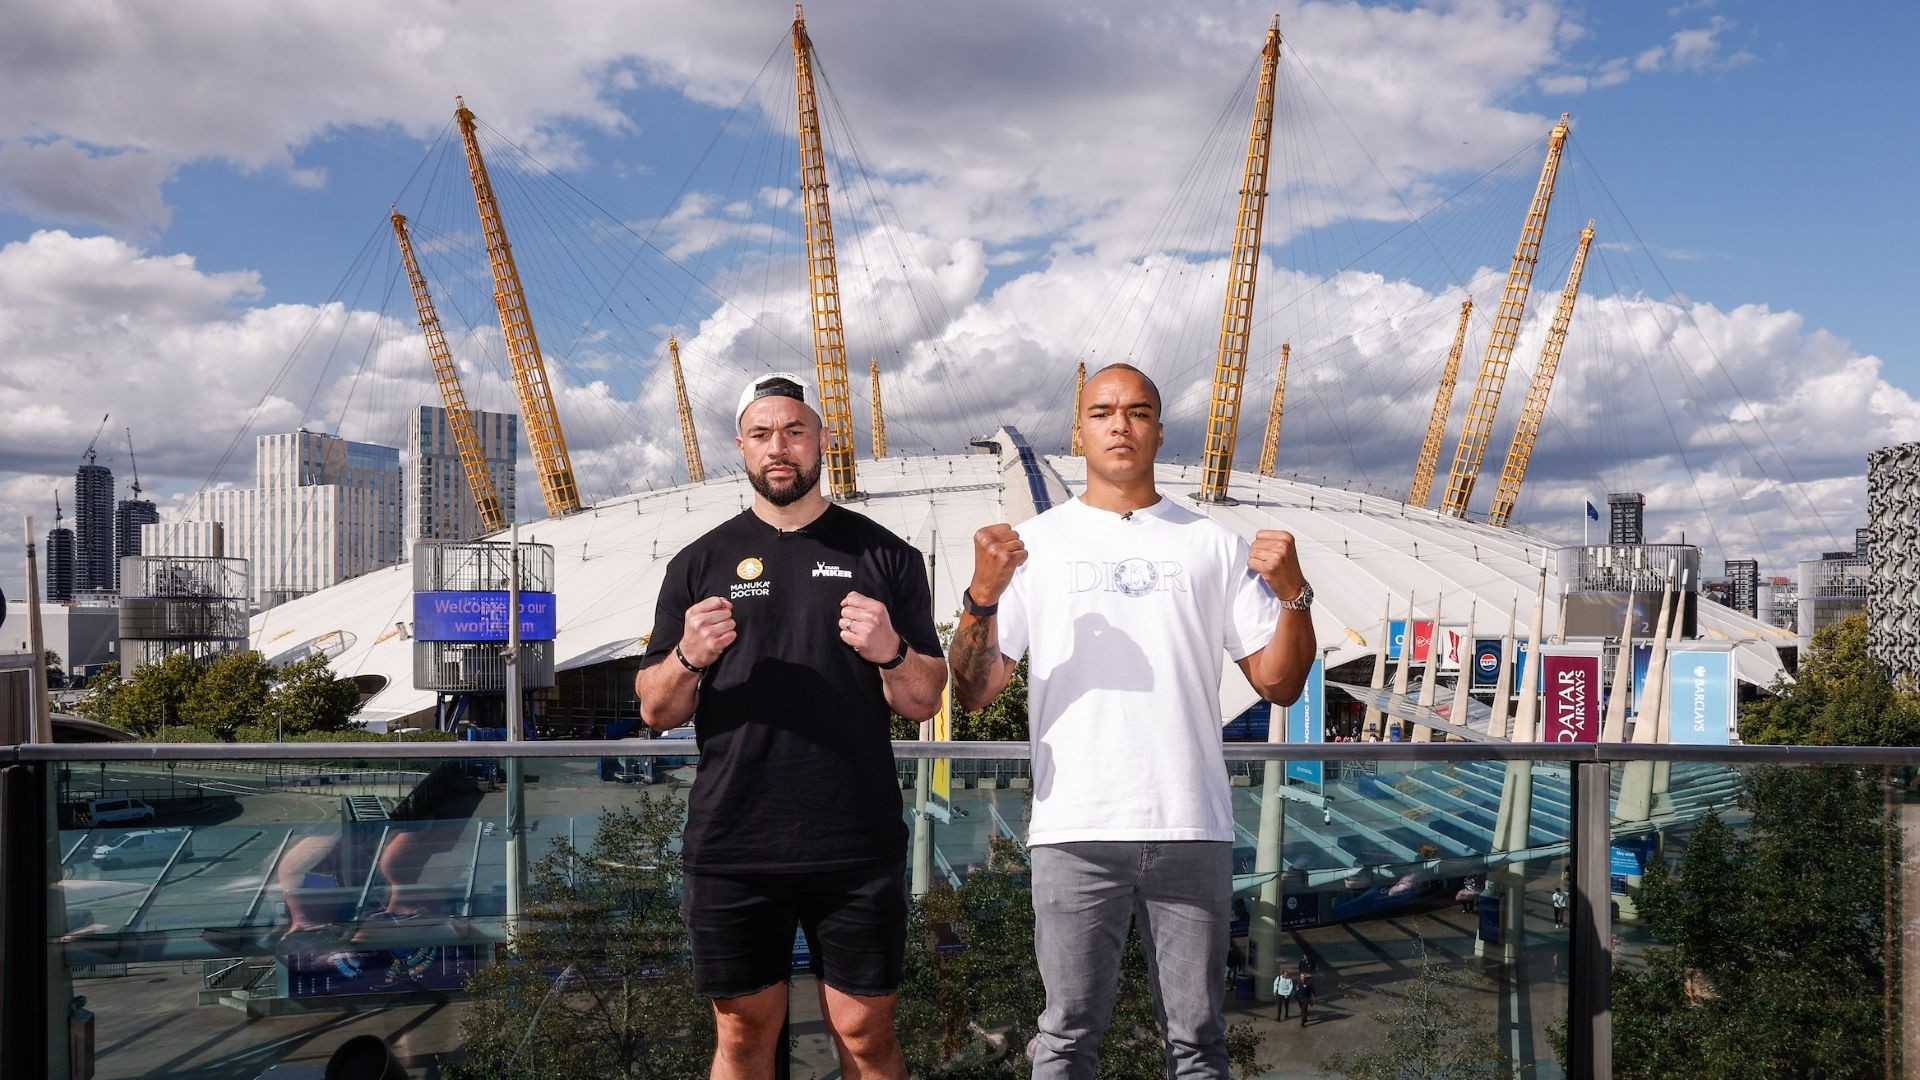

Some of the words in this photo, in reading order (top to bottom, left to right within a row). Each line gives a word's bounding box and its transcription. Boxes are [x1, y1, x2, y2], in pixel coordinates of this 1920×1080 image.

[730, 581, 770, 591] MANUKA
[812, 569, 852, 578] PARKER
[1066, 557, 1187, 598] DIOR
[434, 599, 507, 614] Welcome
[528, 603, 546, 613] our
[730, 588, 770, 599] DOCTOR
[1558, 670, 1577, 742] QATAR
[1575, 670, 1585, 730] AIRWAYS
[1694, 680, 1704, 732] BARCLAYS
